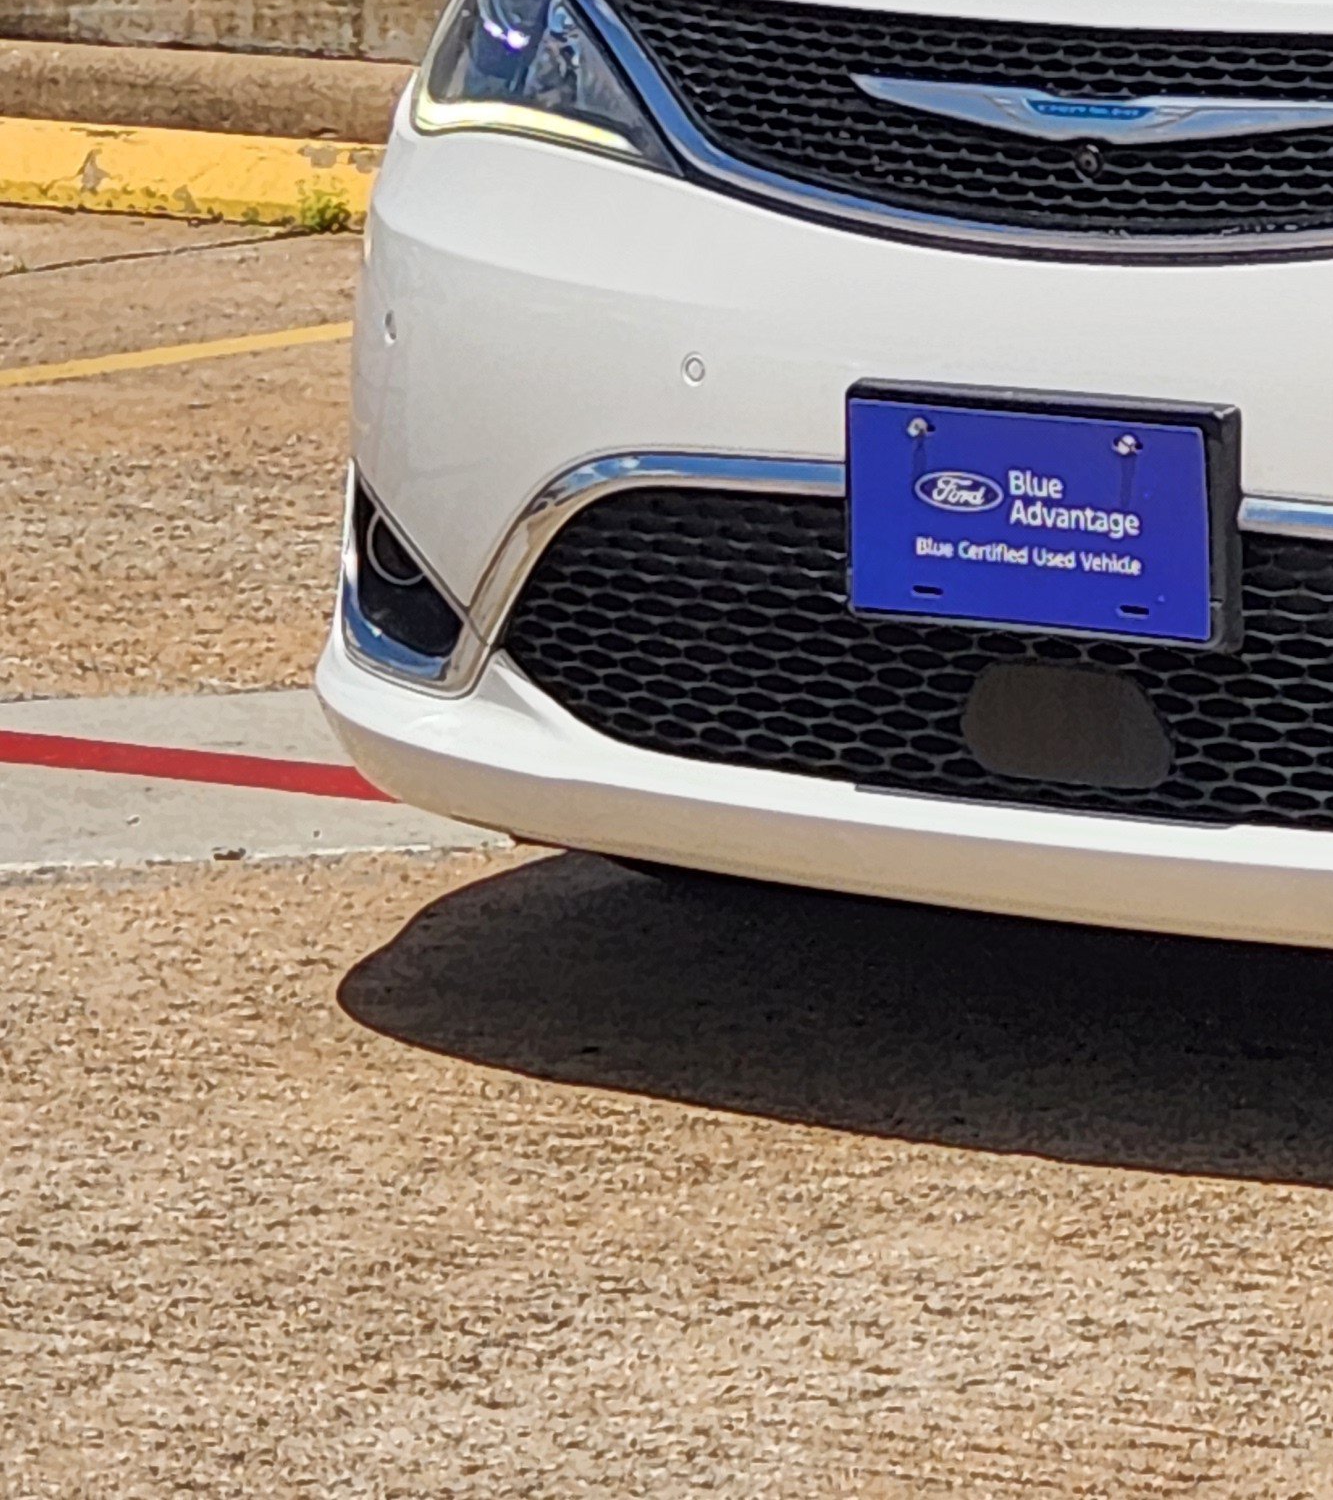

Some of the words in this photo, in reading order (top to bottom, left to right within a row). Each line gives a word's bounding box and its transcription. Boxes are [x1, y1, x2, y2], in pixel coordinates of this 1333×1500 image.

[1007, 469, 1064, 499] Blue
[1009, 500, 1141, 540] Advantage
[915, 536, 955, 558] Blue
[957, 539, 1029, 565] Certified
[1032, 546, 1076, 570] Used
[1079, 551, 1142, 577] Vehicle
